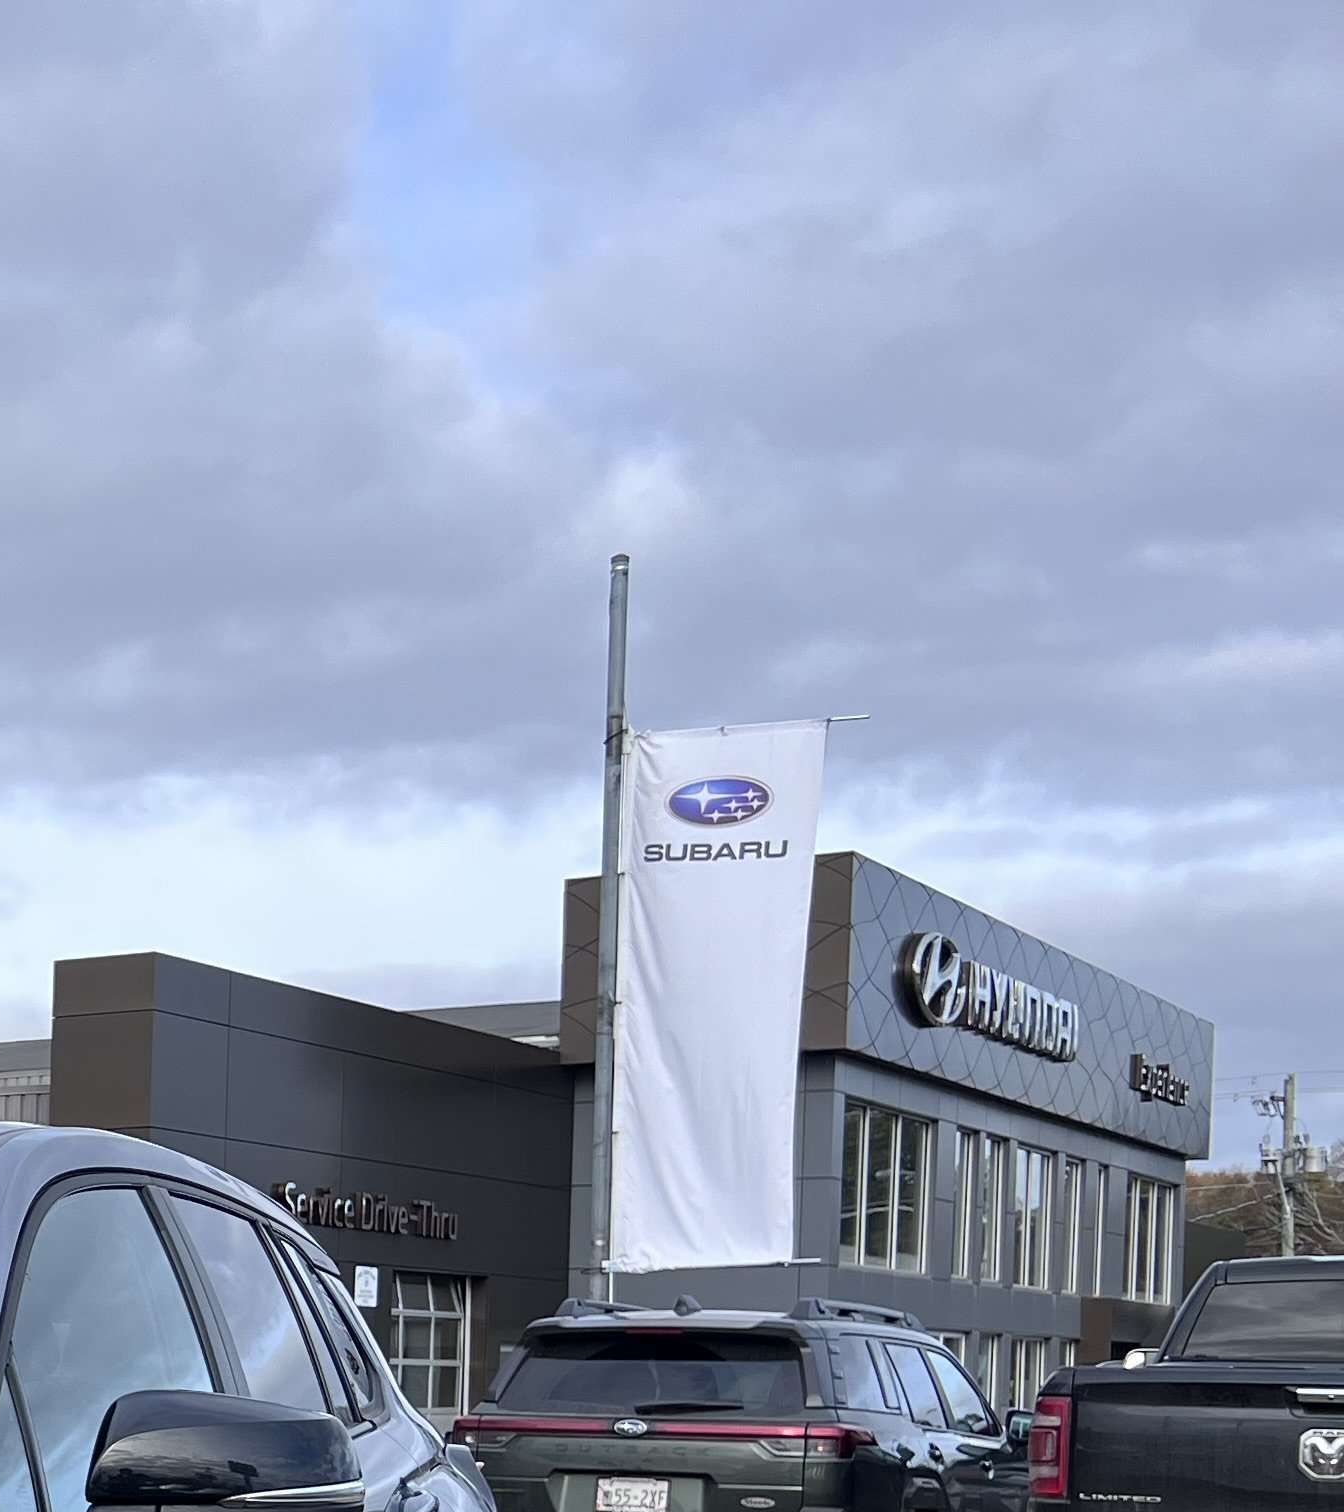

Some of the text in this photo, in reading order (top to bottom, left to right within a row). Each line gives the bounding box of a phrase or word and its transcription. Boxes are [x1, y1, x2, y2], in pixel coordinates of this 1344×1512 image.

[643, 839, 788, 863] SUBARU
[282, 1181, 460, 1241] Service Drive-Thru
[1079, 1492, 1162, 1503] LIMITED
